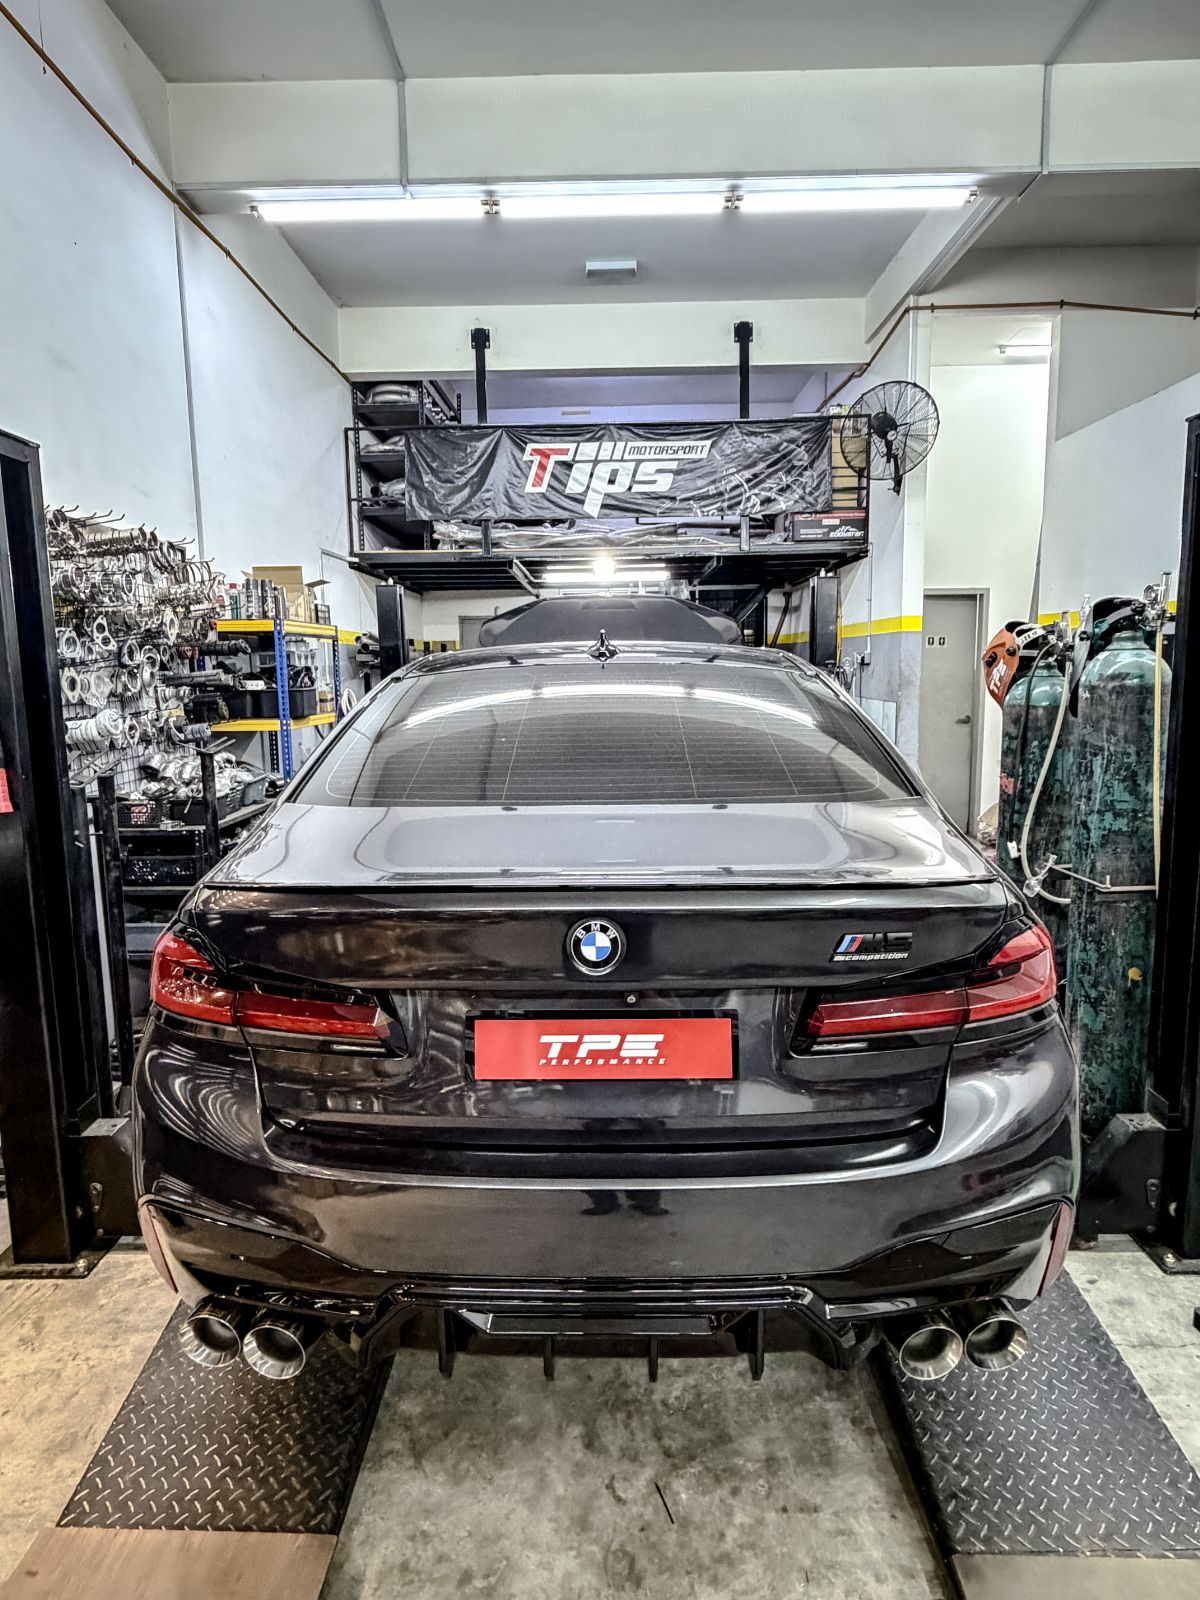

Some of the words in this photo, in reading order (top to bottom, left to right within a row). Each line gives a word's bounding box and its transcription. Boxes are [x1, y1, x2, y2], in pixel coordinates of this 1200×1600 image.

[628, 444, 707, 456] MOTORSPORT
[576, 923, 617, 939] BMW
[859, 932, 912, 952] M5
[539, 1034, 665, 1058] TPE
[538, 1058, 666, 1066] PERFORMANCE
